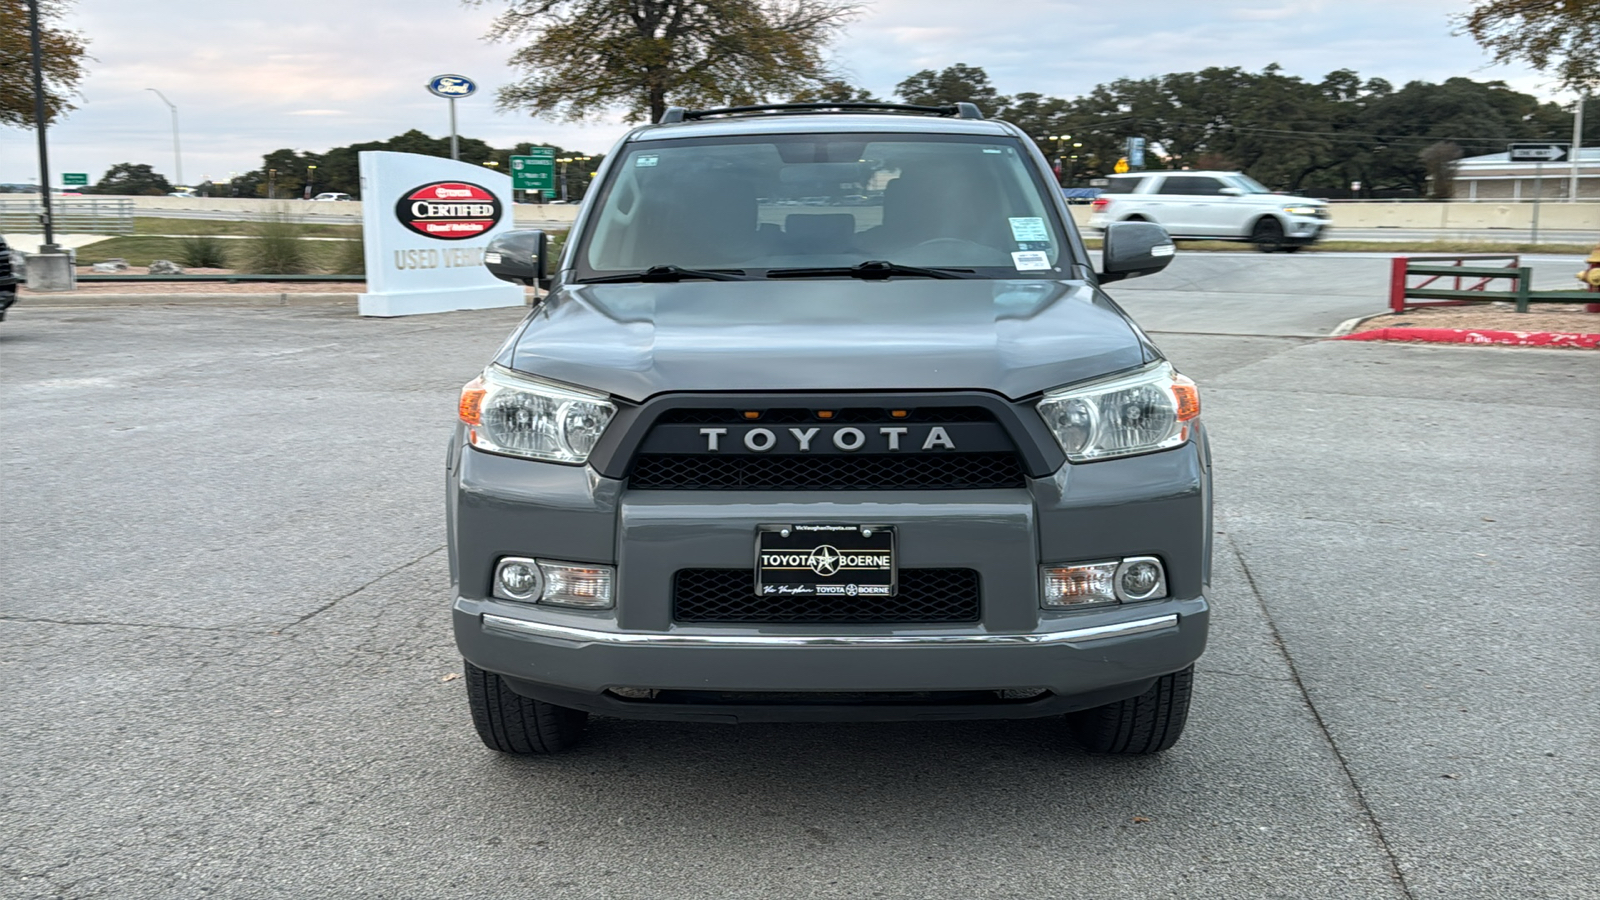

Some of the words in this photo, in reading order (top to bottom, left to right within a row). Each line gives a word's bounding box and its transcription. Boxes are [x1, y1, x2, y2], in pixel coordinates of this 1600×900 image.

[438, 78, 469, 93] Ford
[394, 249, 438, 270] USED
[699, 426, 956, 451] TOYOTA
[761, 555, 817, 566] TOYOTA
[839, 555, 891, 566] BOERNE
[815, 586, 845, 594] TOYOTA
[858, 586, 890, 594] BOERNE
